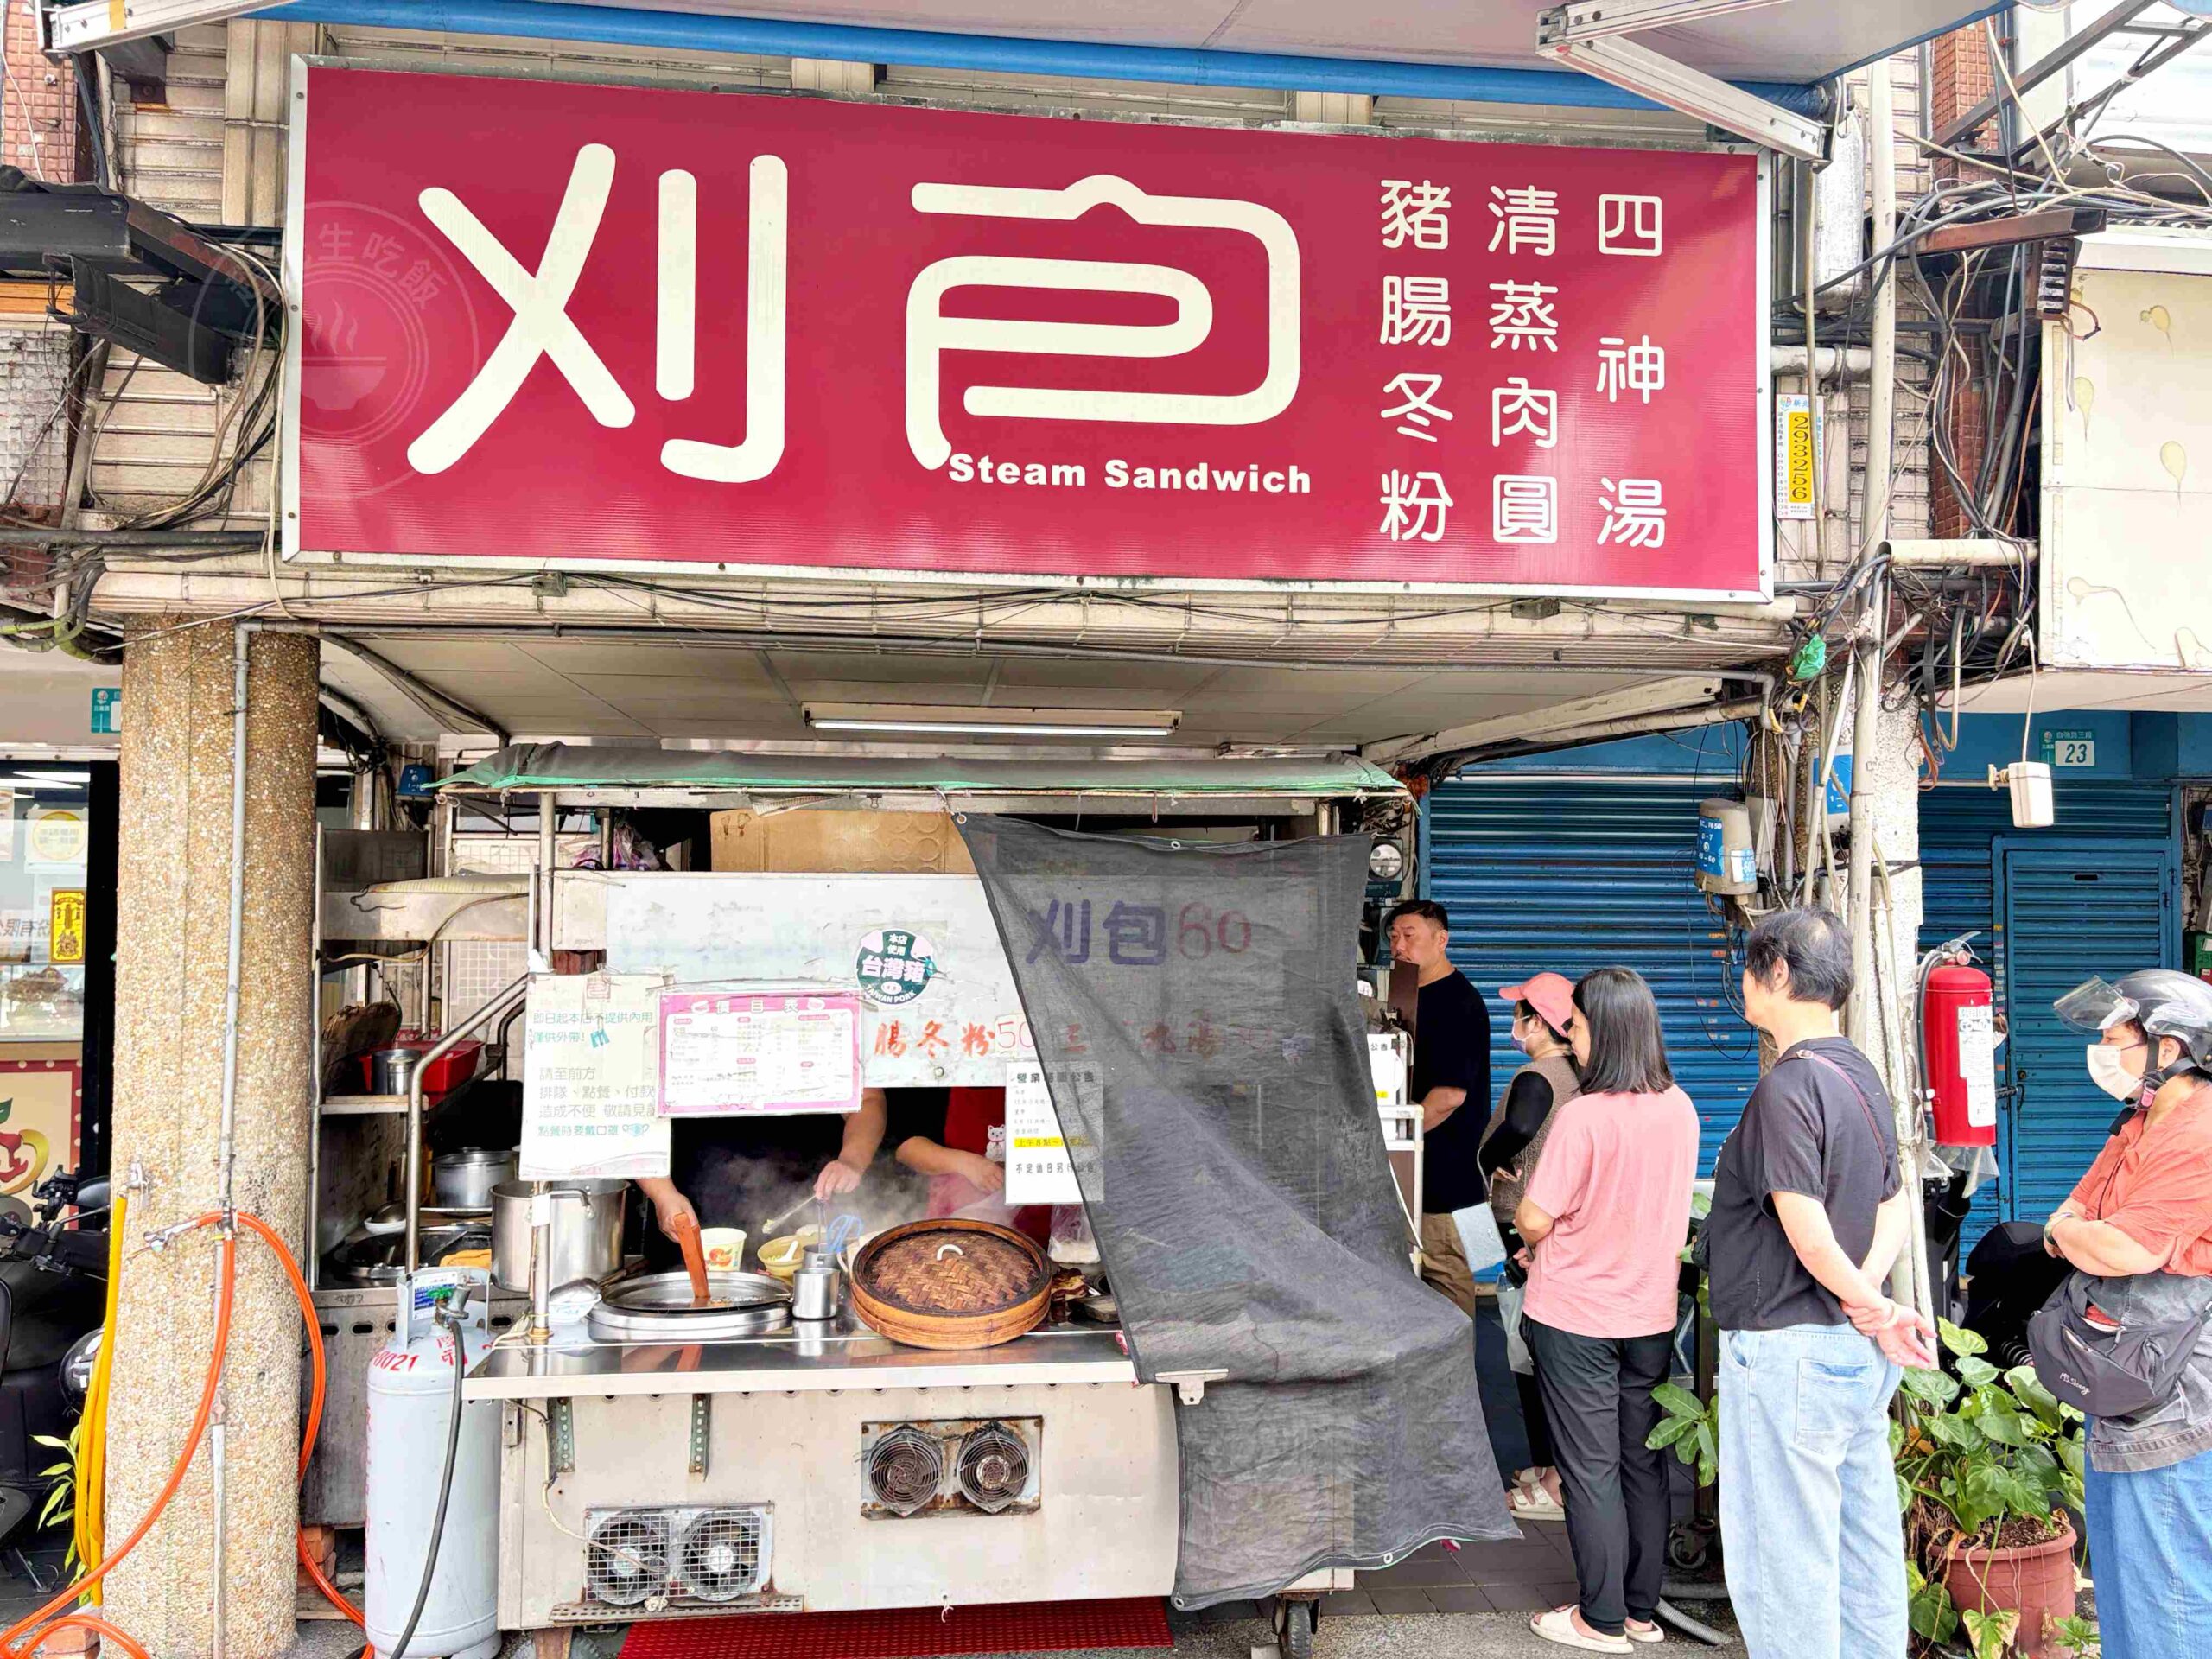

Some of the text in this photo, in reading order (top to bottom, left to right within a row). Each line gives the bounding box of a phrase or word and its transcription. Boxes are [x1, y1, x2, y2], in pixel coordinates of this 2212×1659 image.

[408, 143, 1302, 484] 刈包
[1380, 179, 1454, 543] 豬腸冬粉
[1488, 185, 1561, 546] 清蒸肉圓
[1597, 194, 1669, 550] 四神湯
[949, 454, 1311, 493] Steam Sandwich
[1791, 416, 1809, 500] 293256
[2064, 743, 2088, 764] 23
[1026, 899, 1252, 966] 刈包 60
[893, 989, 917, 1003] PORK
[874, 1020, 995, 1059] 腸冬粉
[539, 1067, 596, 1081] 請至前方
[539, 1103, 596, 1118] 造成不便
